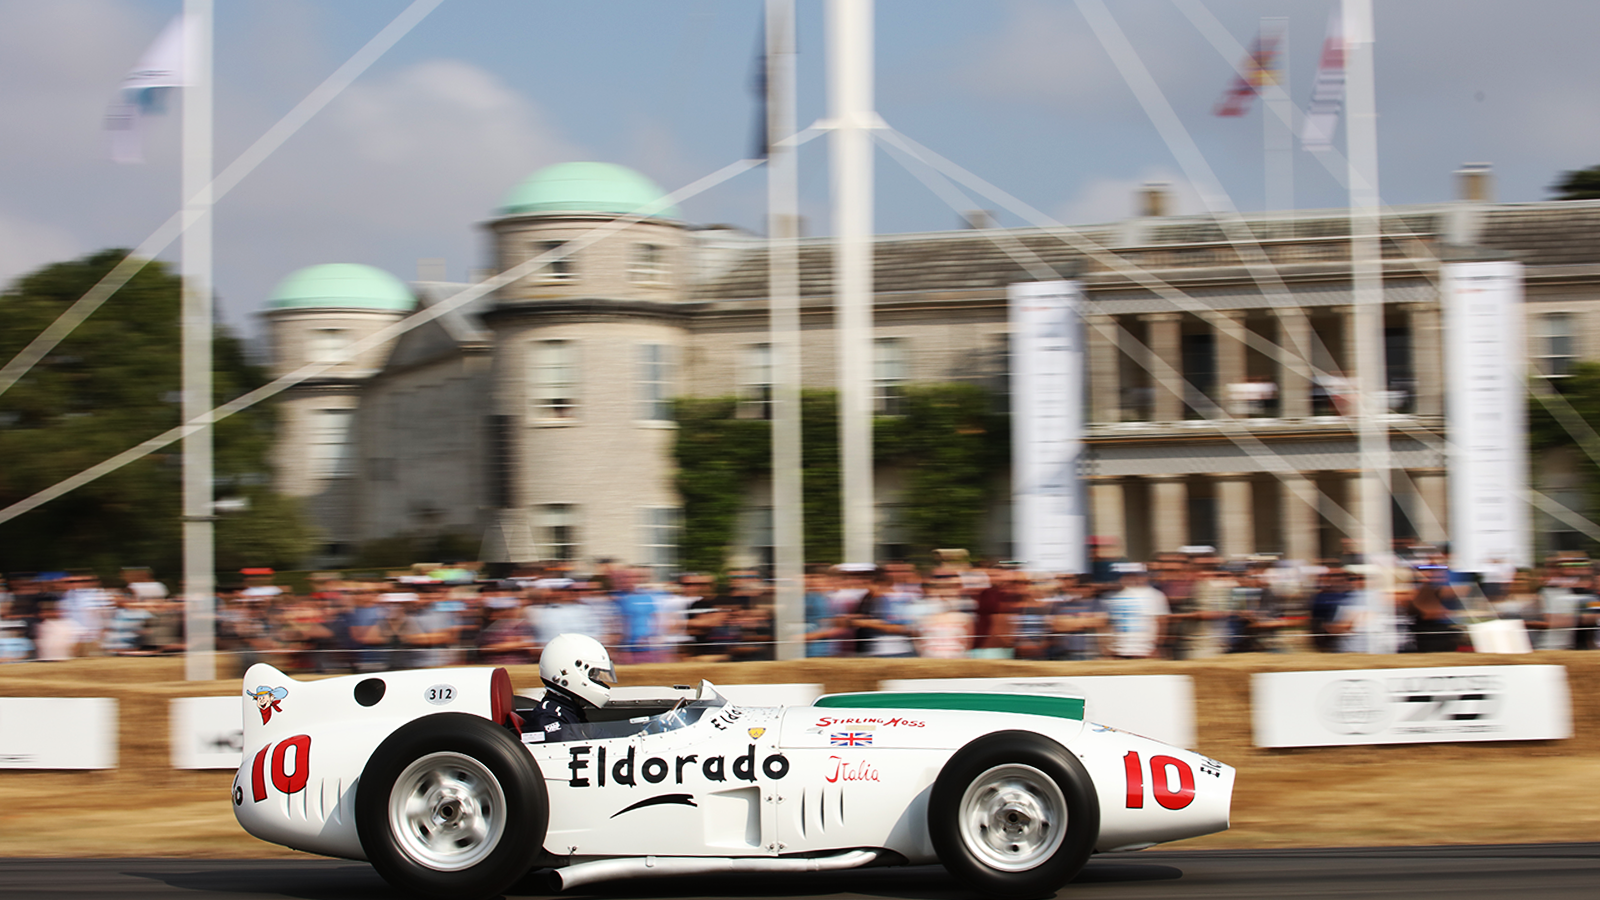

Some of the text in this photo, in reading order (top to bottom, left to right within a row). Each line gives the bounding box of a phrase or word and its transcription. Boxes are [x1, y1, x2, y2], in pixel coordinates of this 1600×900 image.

[429, 688, 453, 701] 312
[815, 716, 926, 728] STIRLING MOSS
[251, 734, 312, 803] 10
[568, 743, 790, 788] Eldorado
[824, 755, 881, 783] Italia
[1123, 750, 1196, 811] 10
